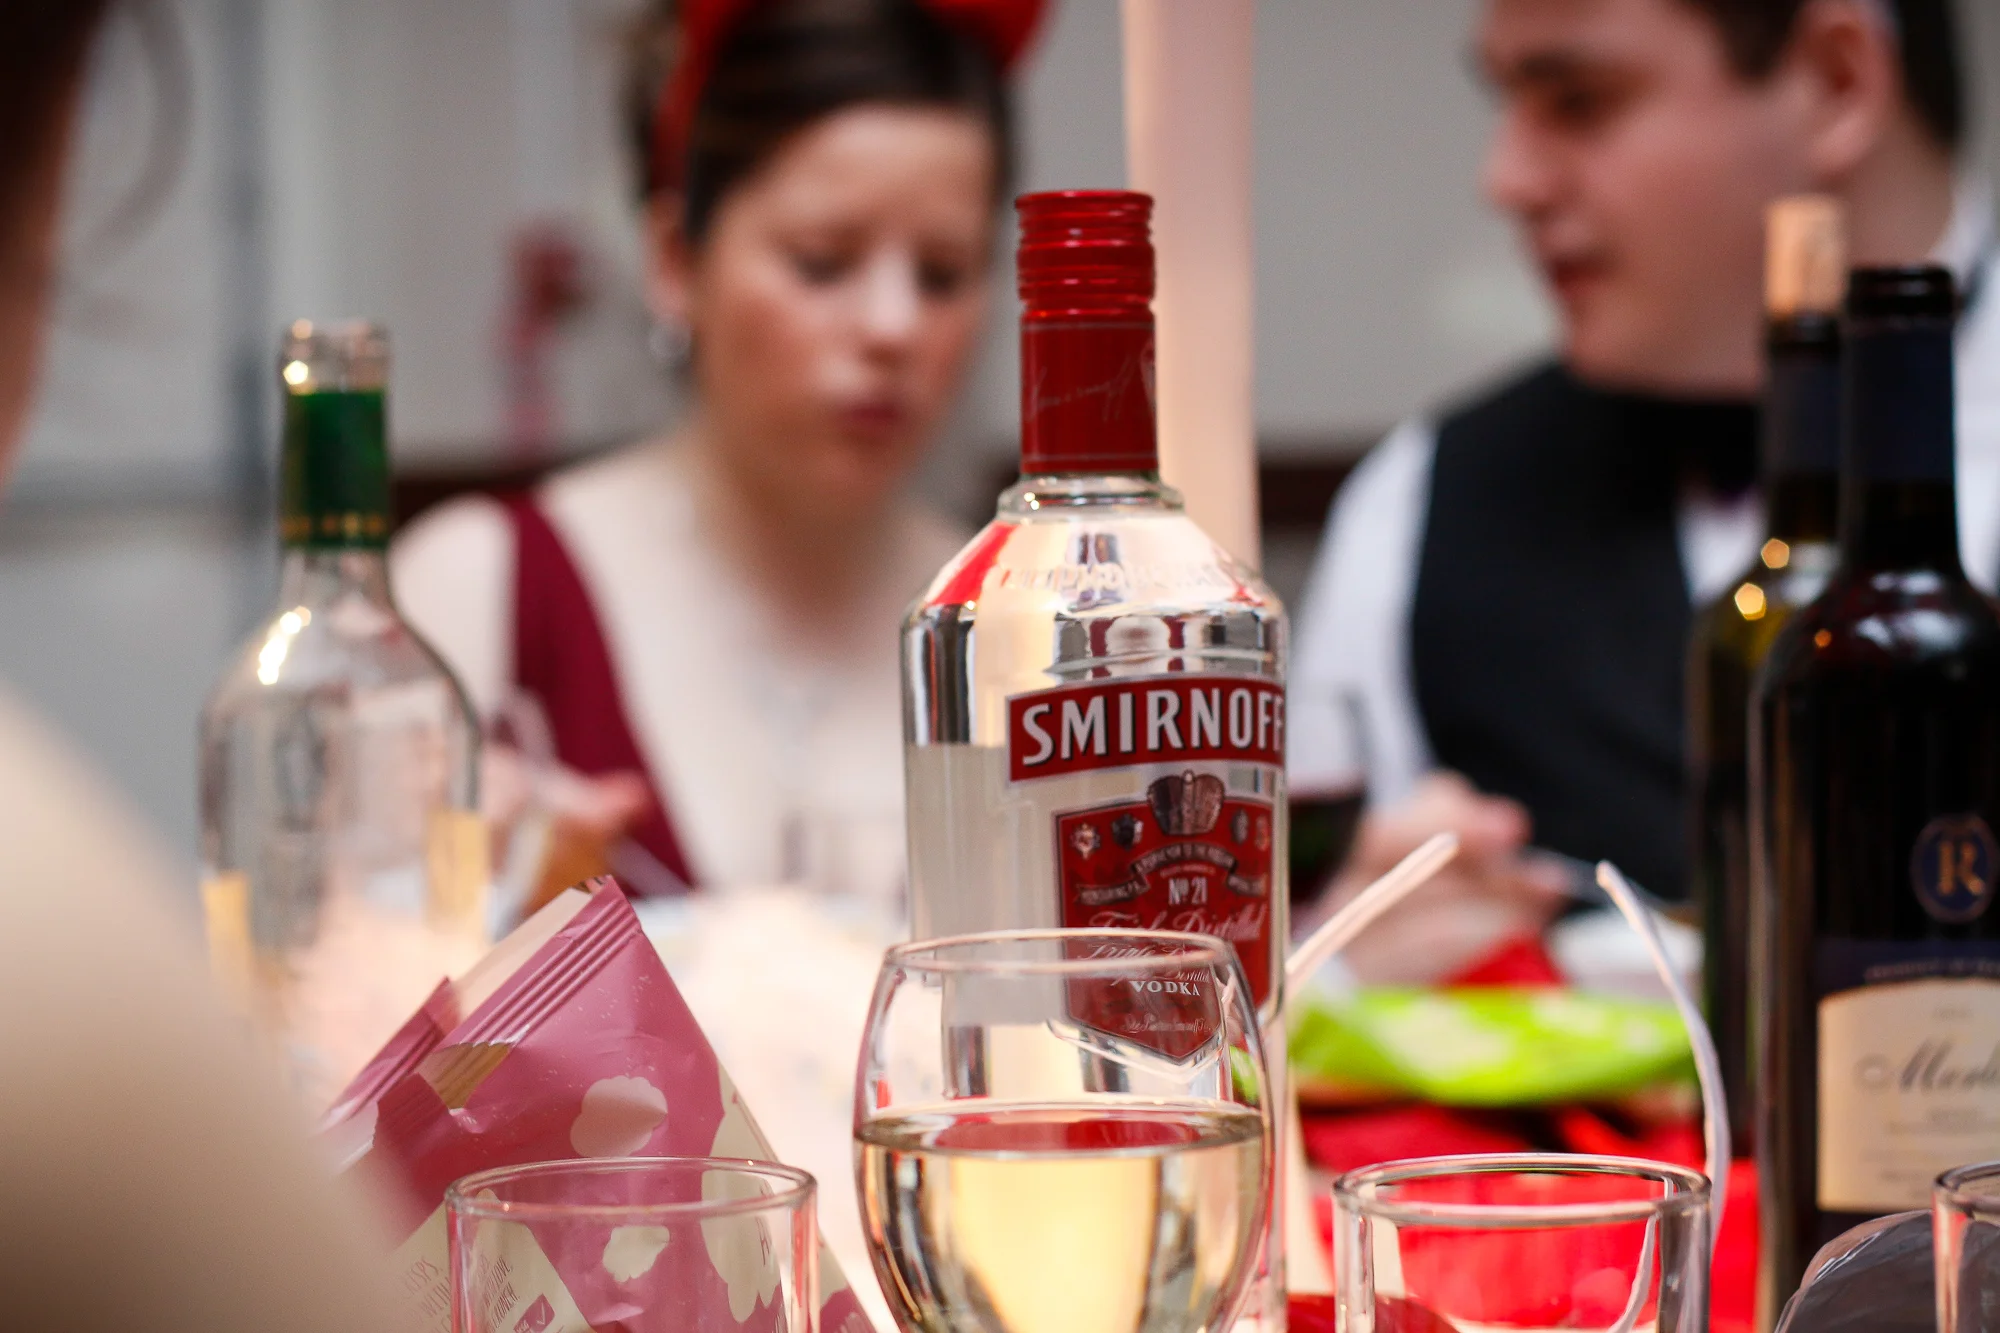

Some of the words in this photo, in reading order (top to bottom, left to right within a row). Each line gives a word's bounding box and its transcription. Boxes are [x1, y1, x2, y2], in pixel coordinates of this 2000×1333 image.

[1936, 839, 1985, 897] R
[1191, 876, 1207, 905] 21
[1129, 980, 1200, 997] VODKA
